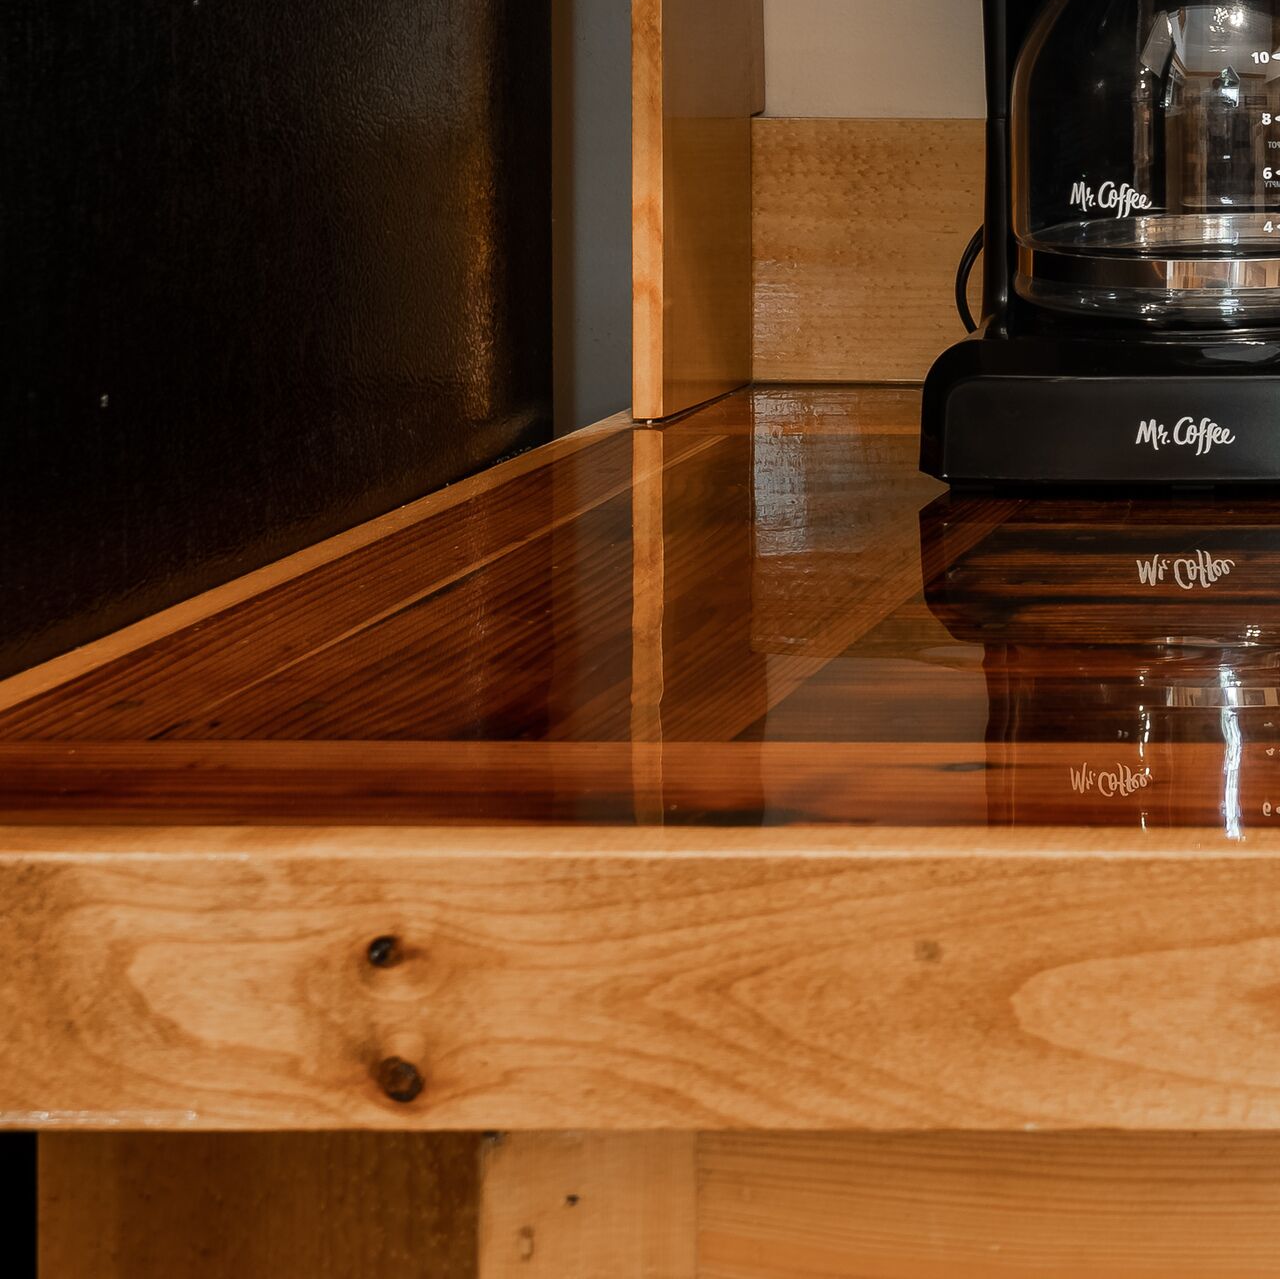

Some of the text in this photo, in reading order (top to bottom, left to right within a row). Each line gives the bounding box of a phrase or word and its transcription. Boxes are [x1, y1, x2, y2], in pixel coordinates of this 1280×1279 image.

[1251, 51, 1270, 64] 10
[1261, 112, 1272, 126] 8
[1262, 167, 1272, 179] 6
[1070, 181, 1152, 219] Mr. Coffee
[1263, 221, 1273, 233] 4
[1136, 416, 1236, 456] Mr. Coffee
